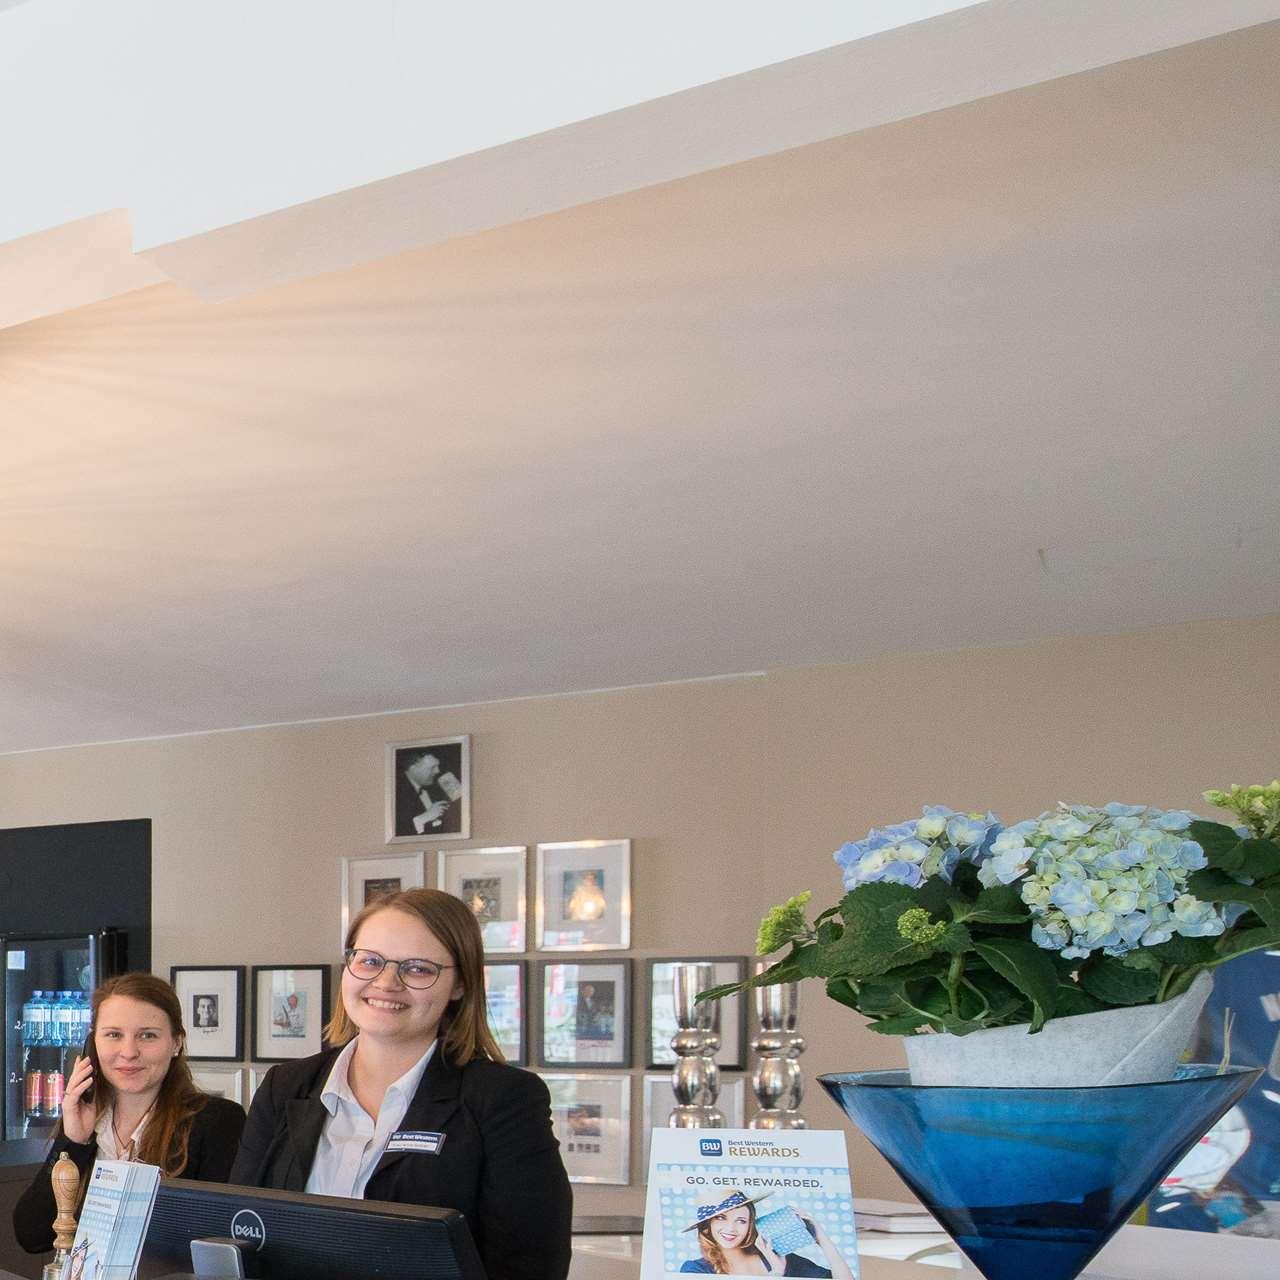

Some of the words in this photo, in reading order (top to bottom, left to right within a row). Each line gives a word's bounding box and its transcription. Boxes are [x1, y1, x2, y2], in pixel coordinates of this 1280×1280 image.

[702, 1142, 720, 1151] BW
[729, 1147, 800, 1158] REWARDS
[686, 1176, 709, 1185] GO.
[712, 1177, 740, 1186] GET.
[744, 1178, 823, 1188] REWARDED.
[235, 1224, 262, 1238] DELL
